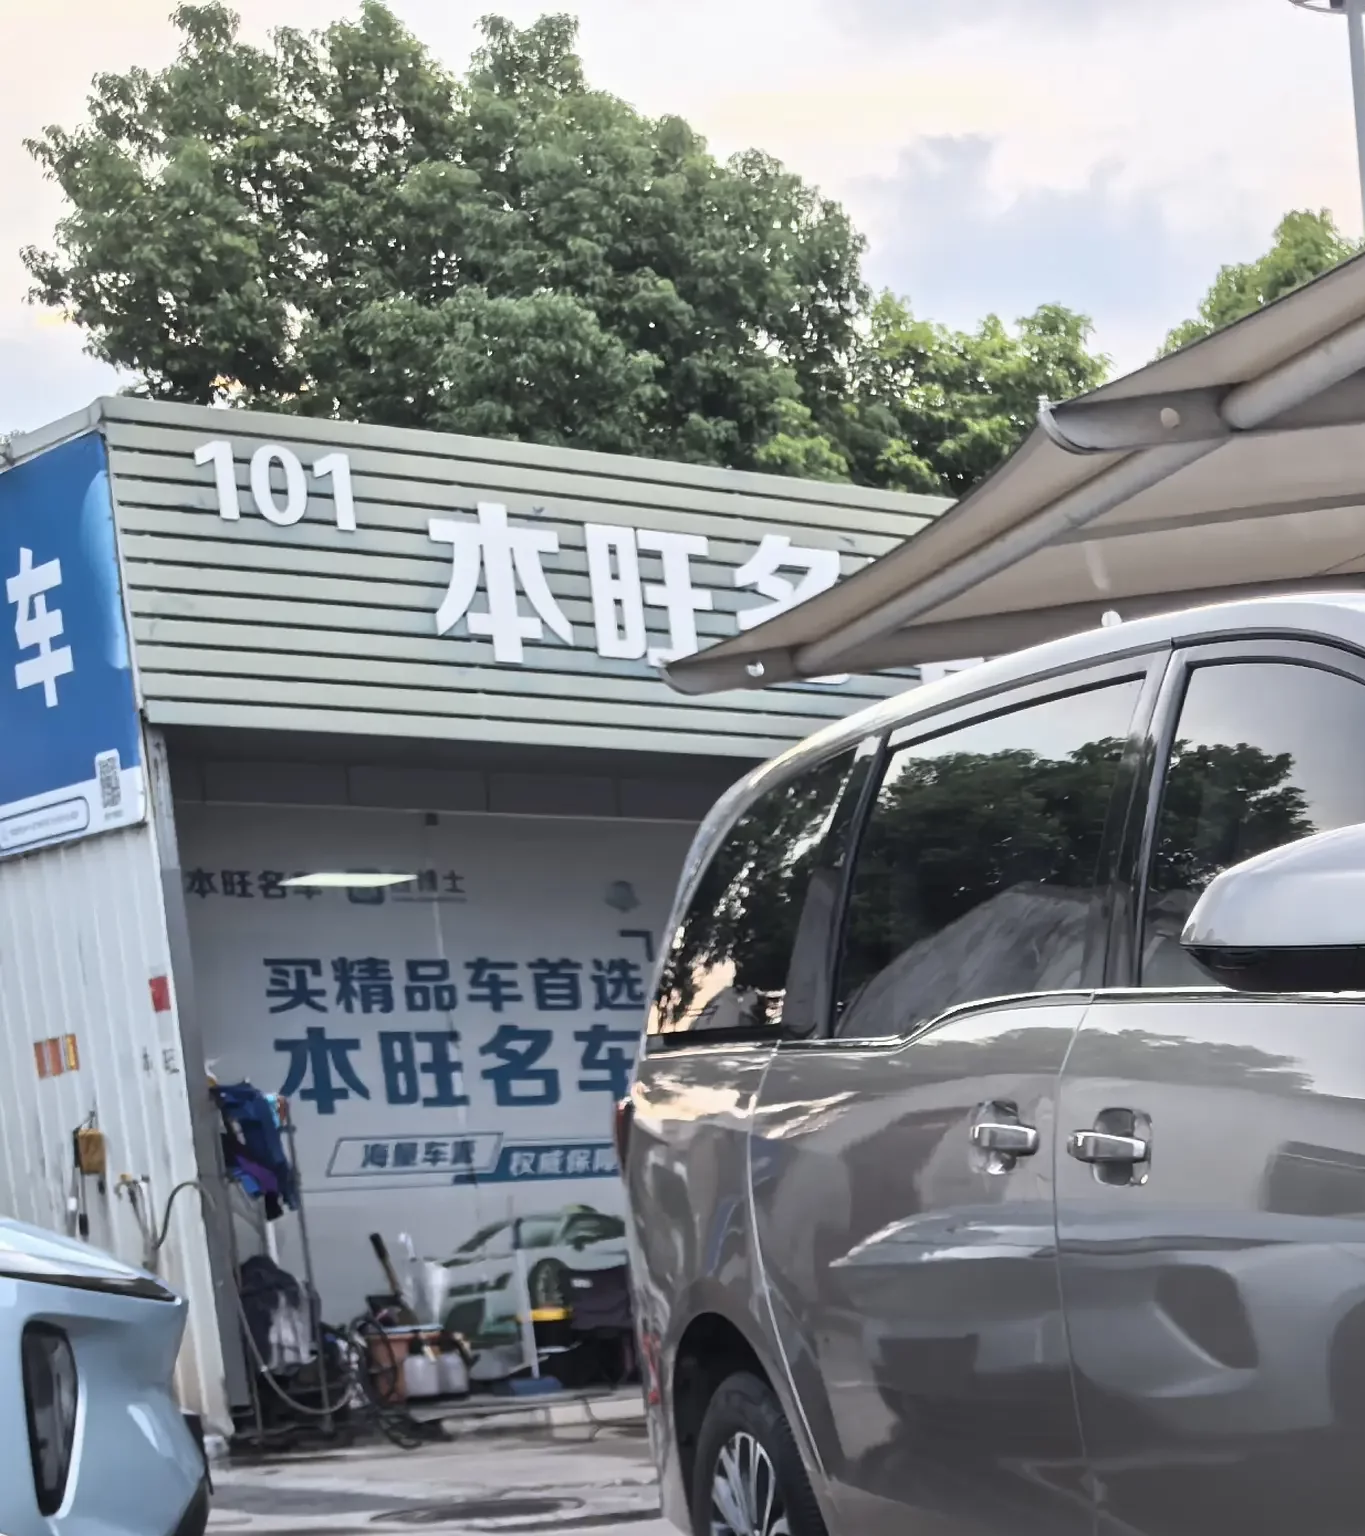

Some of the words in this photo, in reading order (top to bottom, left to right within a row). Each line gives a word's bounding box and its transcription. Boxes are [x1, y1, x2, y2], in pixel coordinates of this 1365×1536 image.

[194, 440, 357, 532] 101
[6, 547, 74, 708] 车
[263, 956, 646, 1014] 买精品车首选
[274, 1023, 642, 1115] 本旺名车
